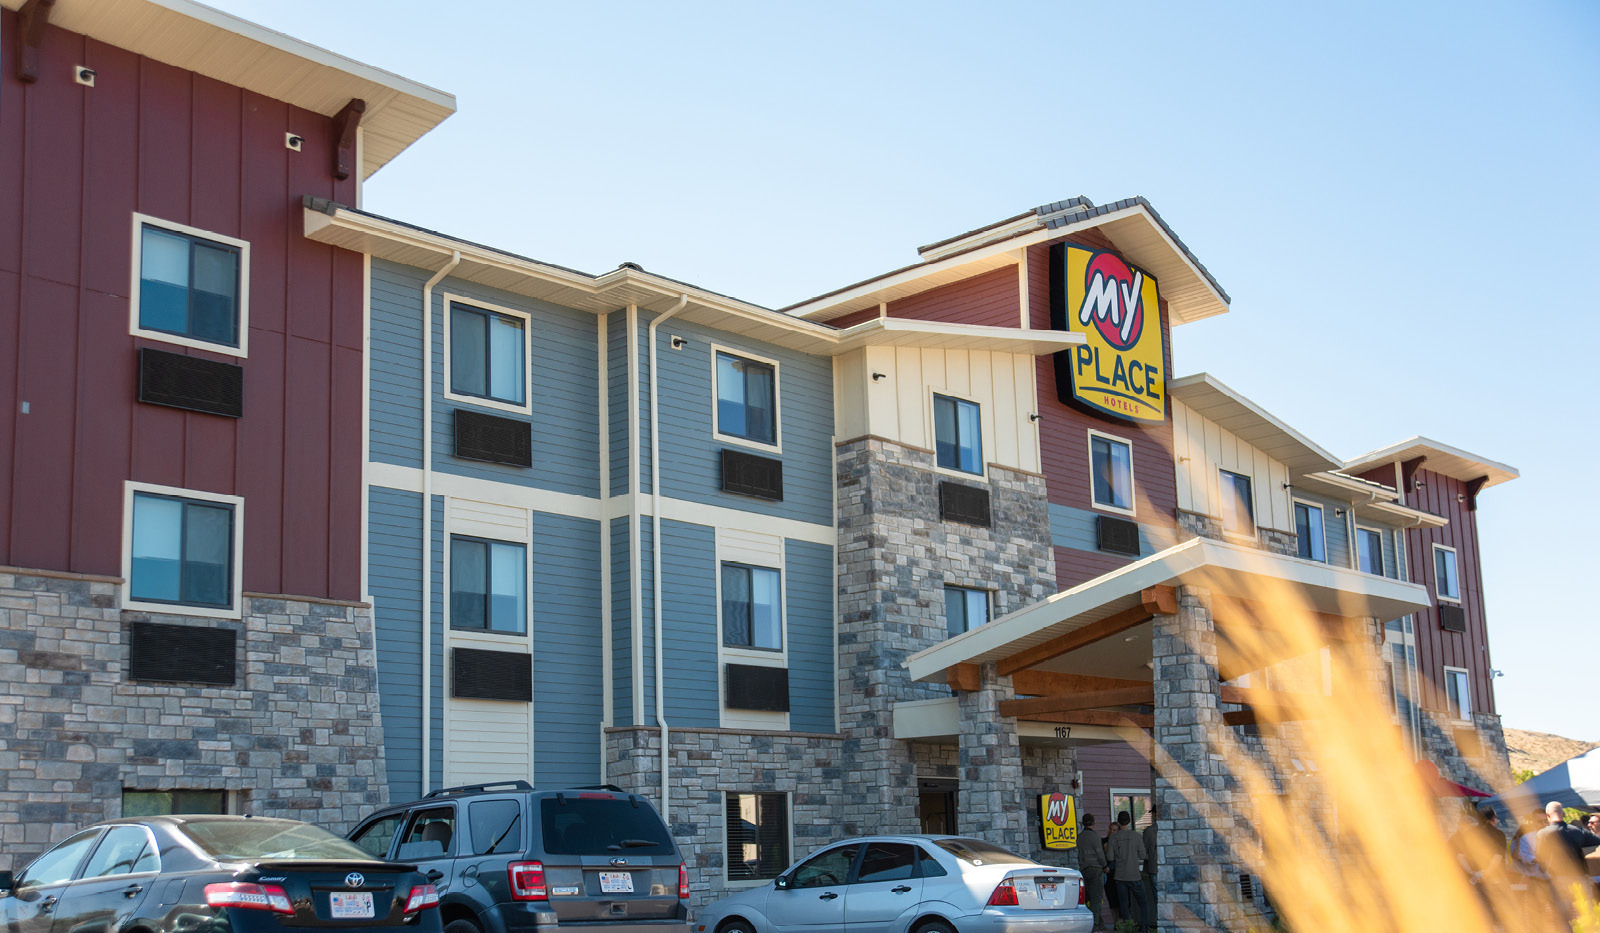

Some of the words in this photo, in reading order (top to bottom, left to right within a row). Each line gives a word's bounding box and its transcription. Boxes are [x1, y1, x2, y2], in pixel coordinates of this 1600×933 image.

[1077, 344, 1160, 400] PLACE
[1103, 395, 1139, 414] HOTELS
[1054, 726, 1071, 738] 1167
[1046, 827, 1075, 840] PLACE
